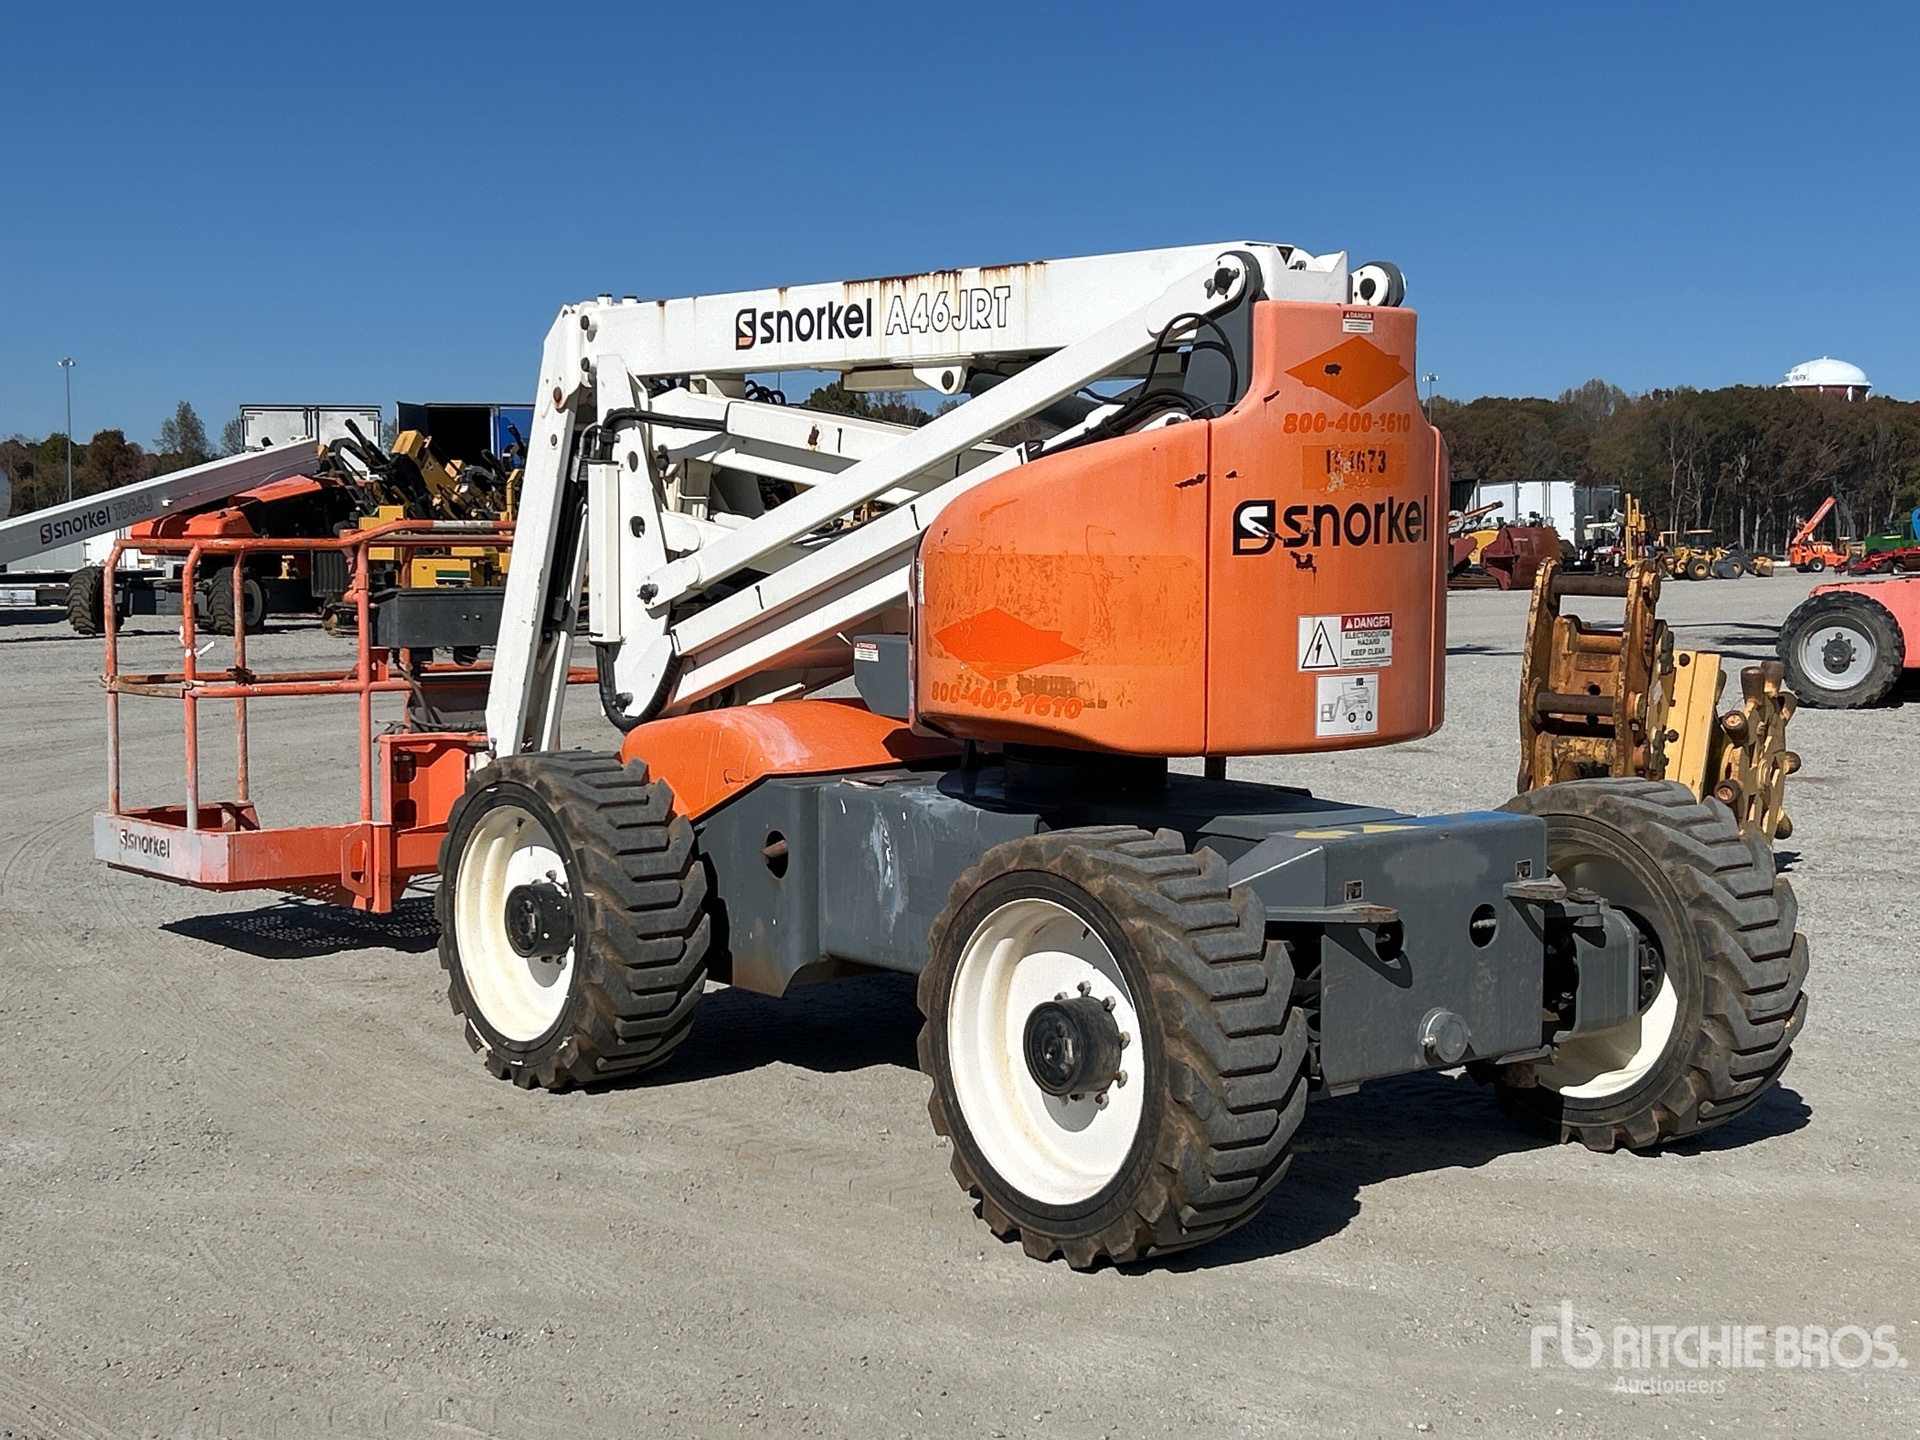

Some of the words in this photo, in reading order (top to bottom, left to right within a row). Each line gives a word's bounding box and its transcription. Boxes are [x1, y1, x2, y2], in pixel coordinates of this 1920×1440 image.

[760, 298, 872, 345] snorkel
[885, 285, 1011, 336] A46JRT
[1283, 412, 1411, 434] 800-400-1610
[53, 506, 111, 540] snorkel
[1283, 495, 1428, 548] snorkel
[1353, 616, 1390, 629] DANGER
[1351, 648, 1366, 656] KEEP
[1367, 647, 1386, 656] CLEAR
[1357, 638, 1380, 646] HAZARD
[931, 680, 1084, 719] 800-400-1610
[127, 832, 170, 858] snorkel
